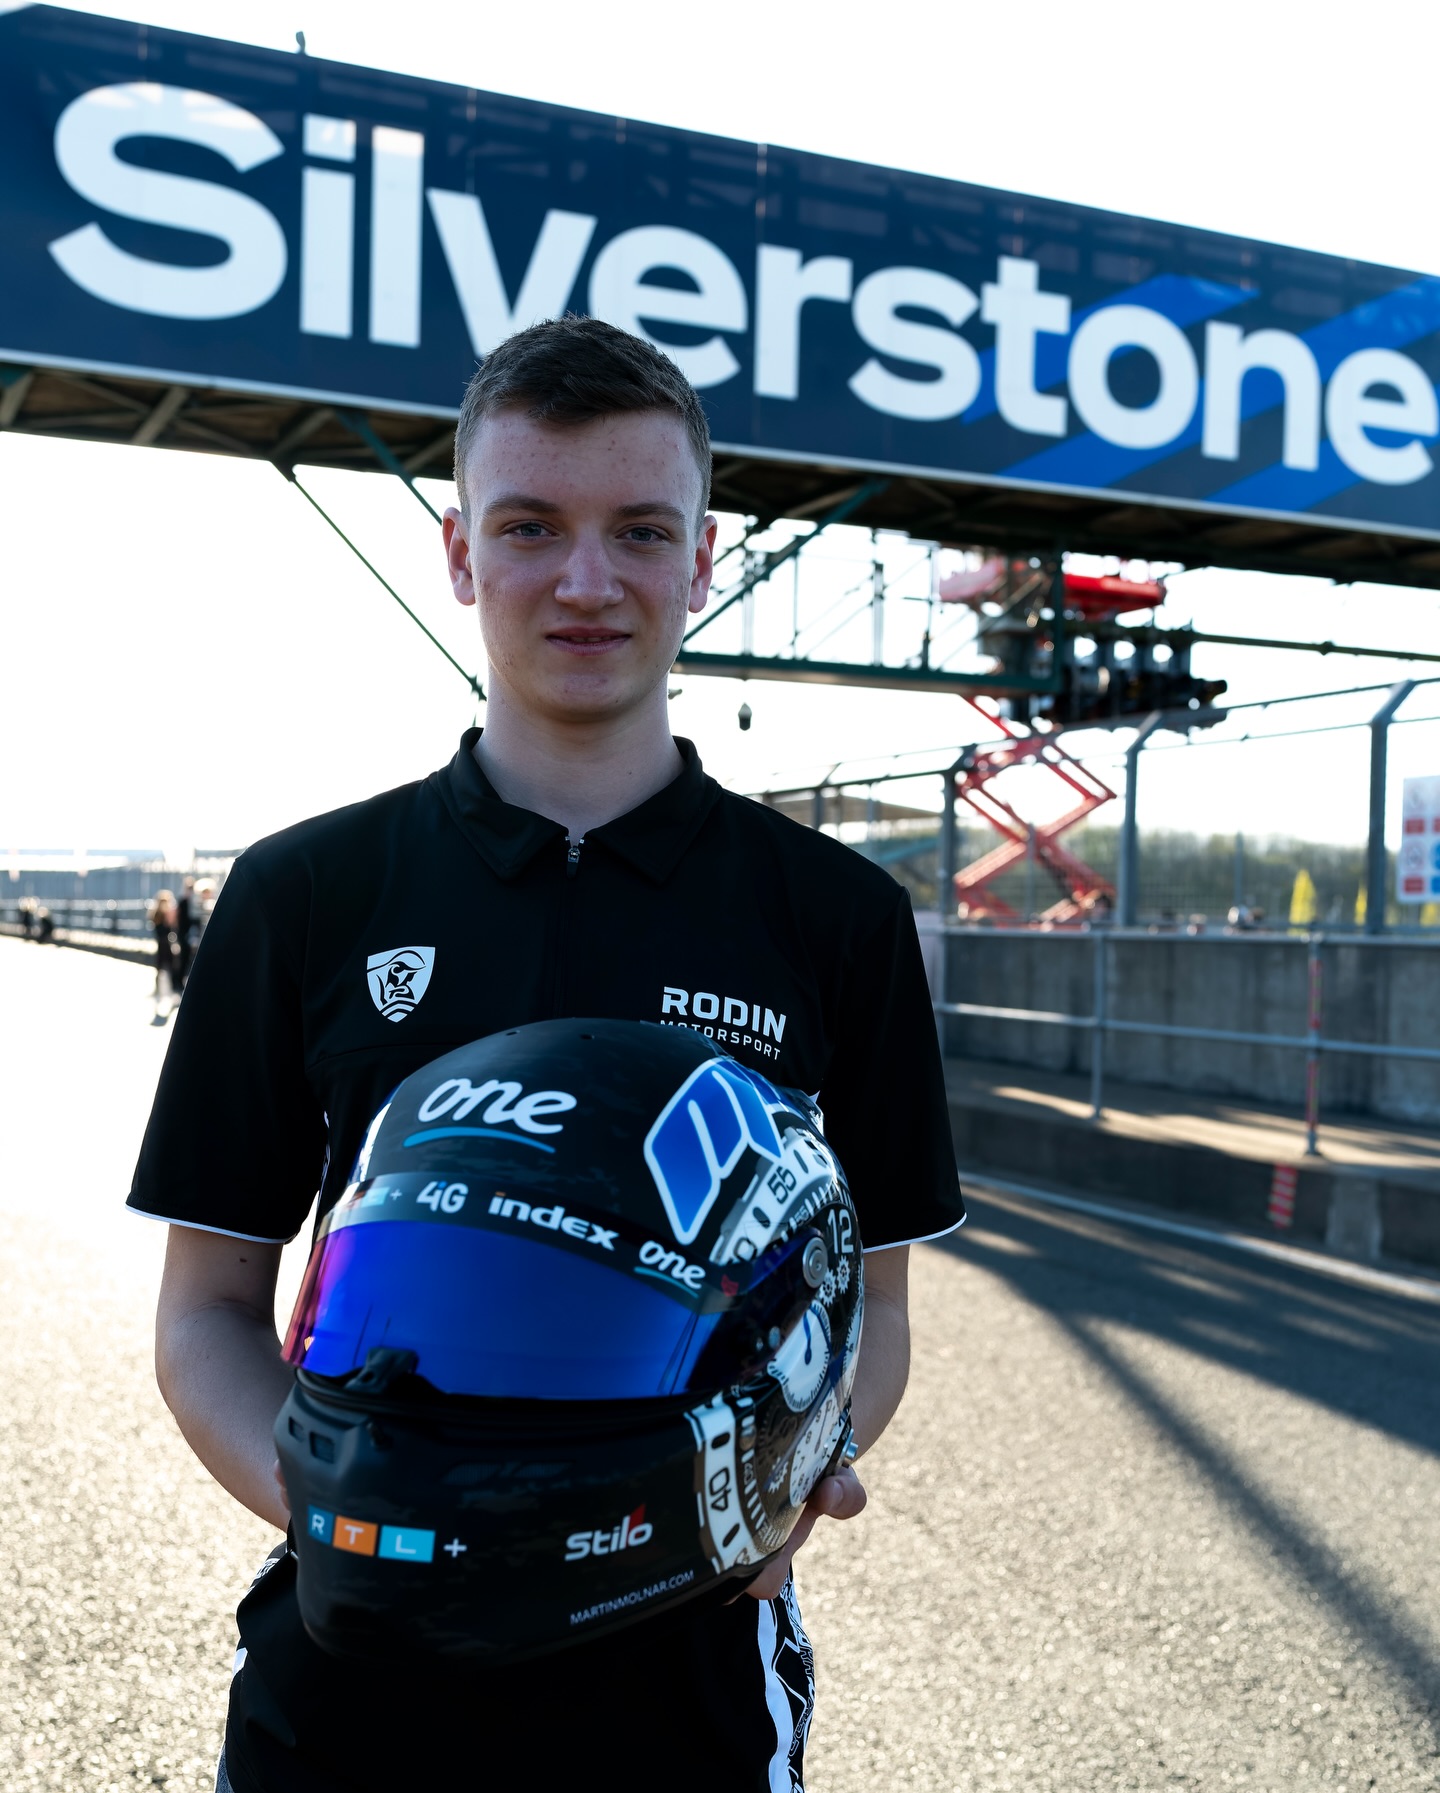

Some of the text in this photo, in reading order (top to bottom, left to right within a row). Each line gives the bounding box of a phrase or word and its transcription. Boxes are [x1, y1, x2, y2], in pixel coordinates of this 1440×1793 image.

[47, 80, 1439, 486] Silverstone
[661, 986, 787, 1043] RODIN
[417, 1077, 578, 1134] one
[767, 1166, 797, 1204] 55
[488, 1191, 620, 1251] index
[827, 1208, 854, 1254] 12
[638, 1240, 706, 1290] one
[708, 1467, 732, 1512] 40
[565, 1510, 653, 1562] Stilo
[570, 1570, 695, 1626] MARTINMOLNAR.COM
